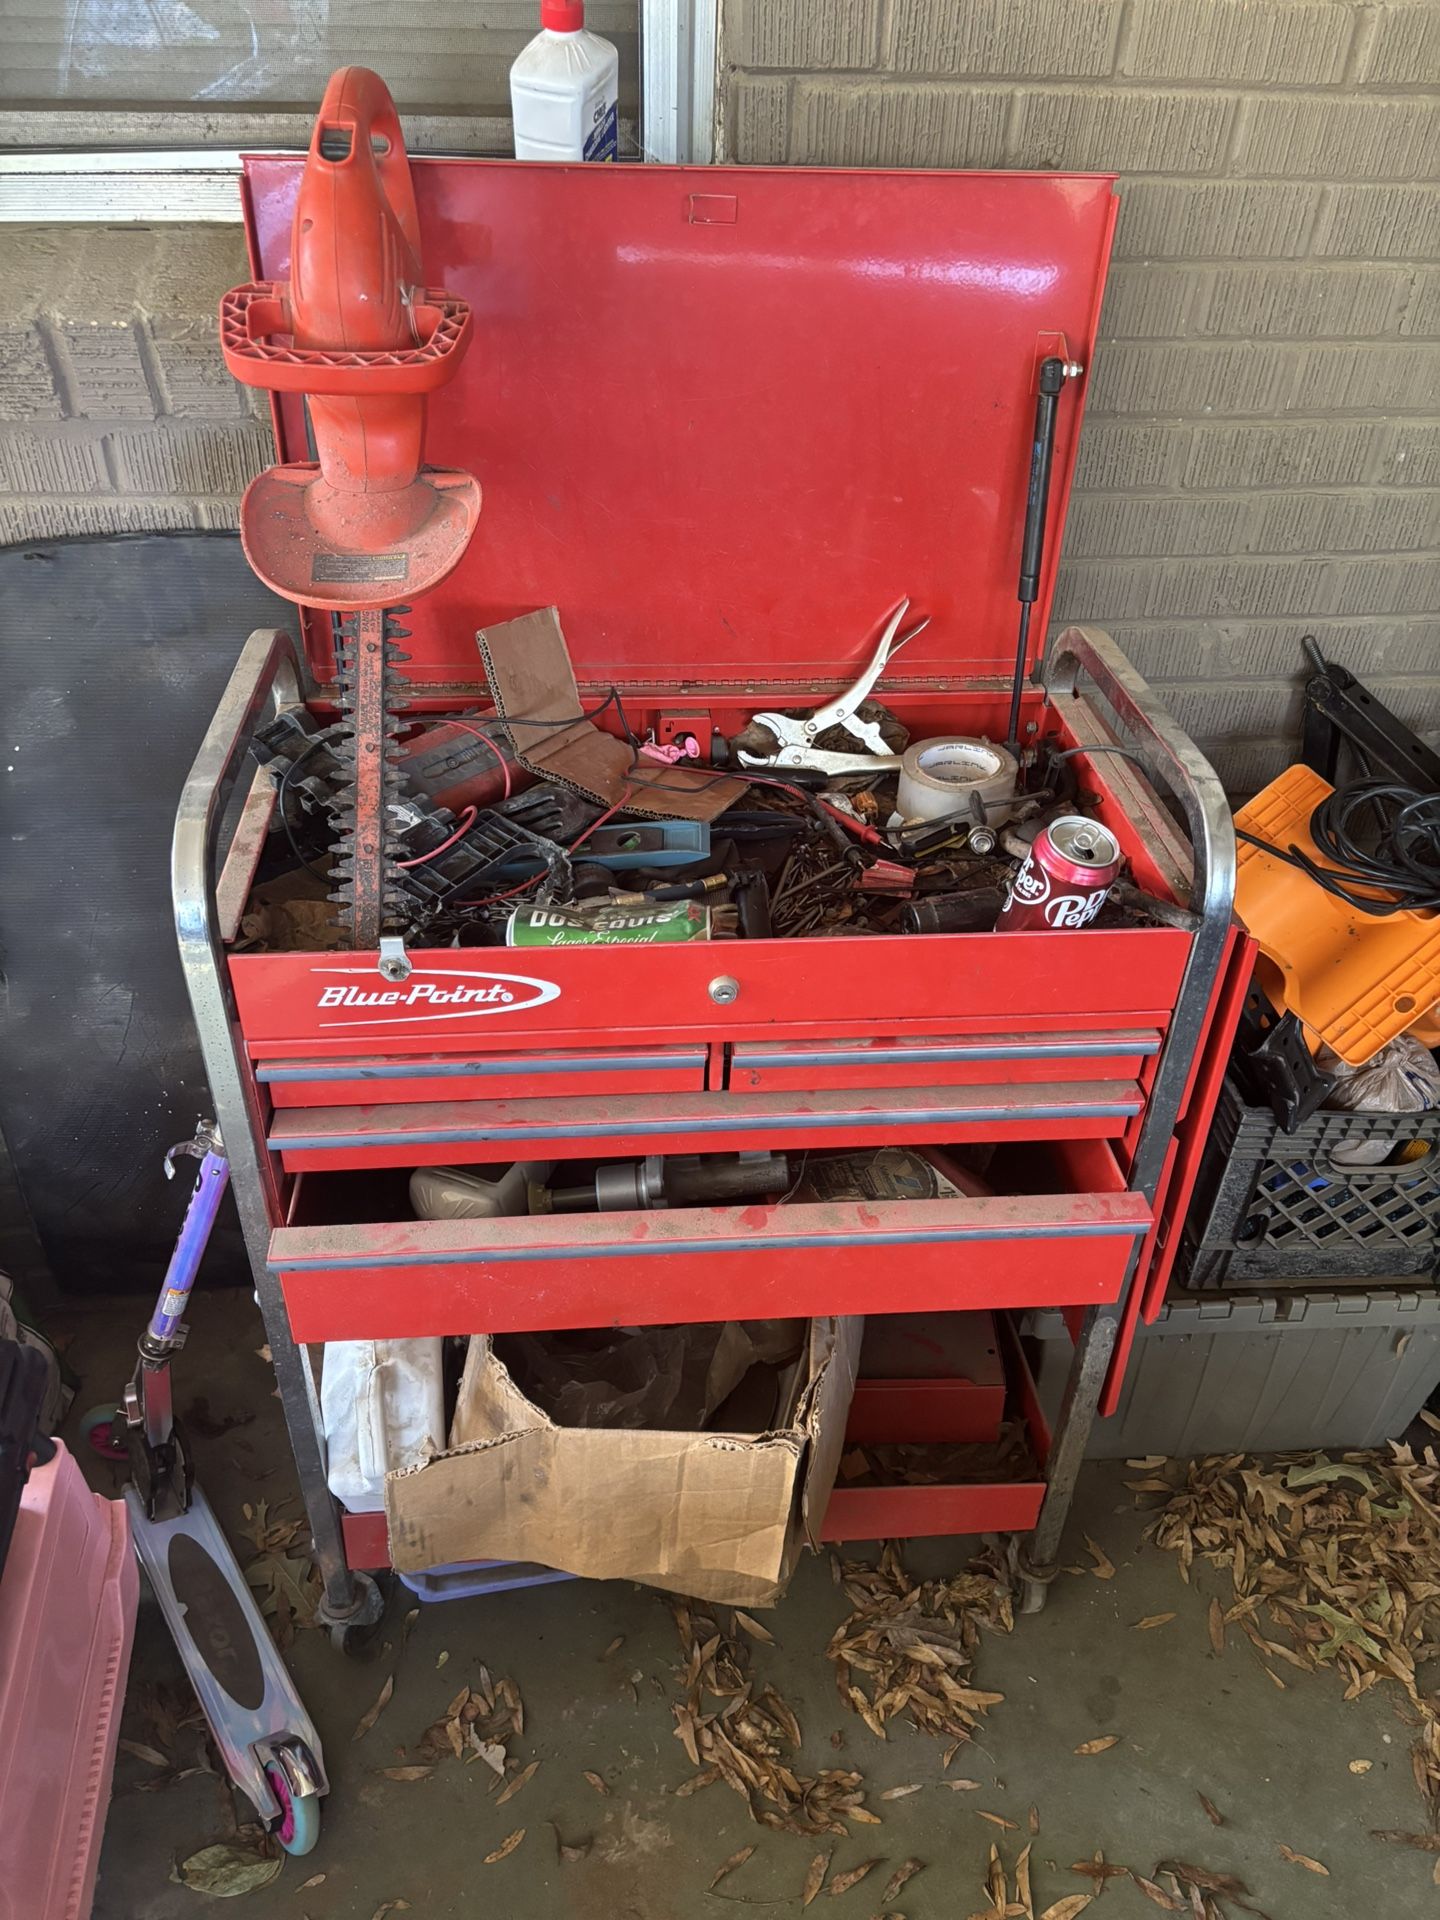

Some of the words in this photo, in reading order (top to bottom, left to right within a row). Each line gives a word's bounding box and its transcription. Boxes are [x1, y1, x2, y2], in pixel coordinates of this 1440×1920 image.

[529, 910, 585, 928] DOS
[592, 912, 674, 931] EQUIS
[1045, 894, 1100, 928] Pep
